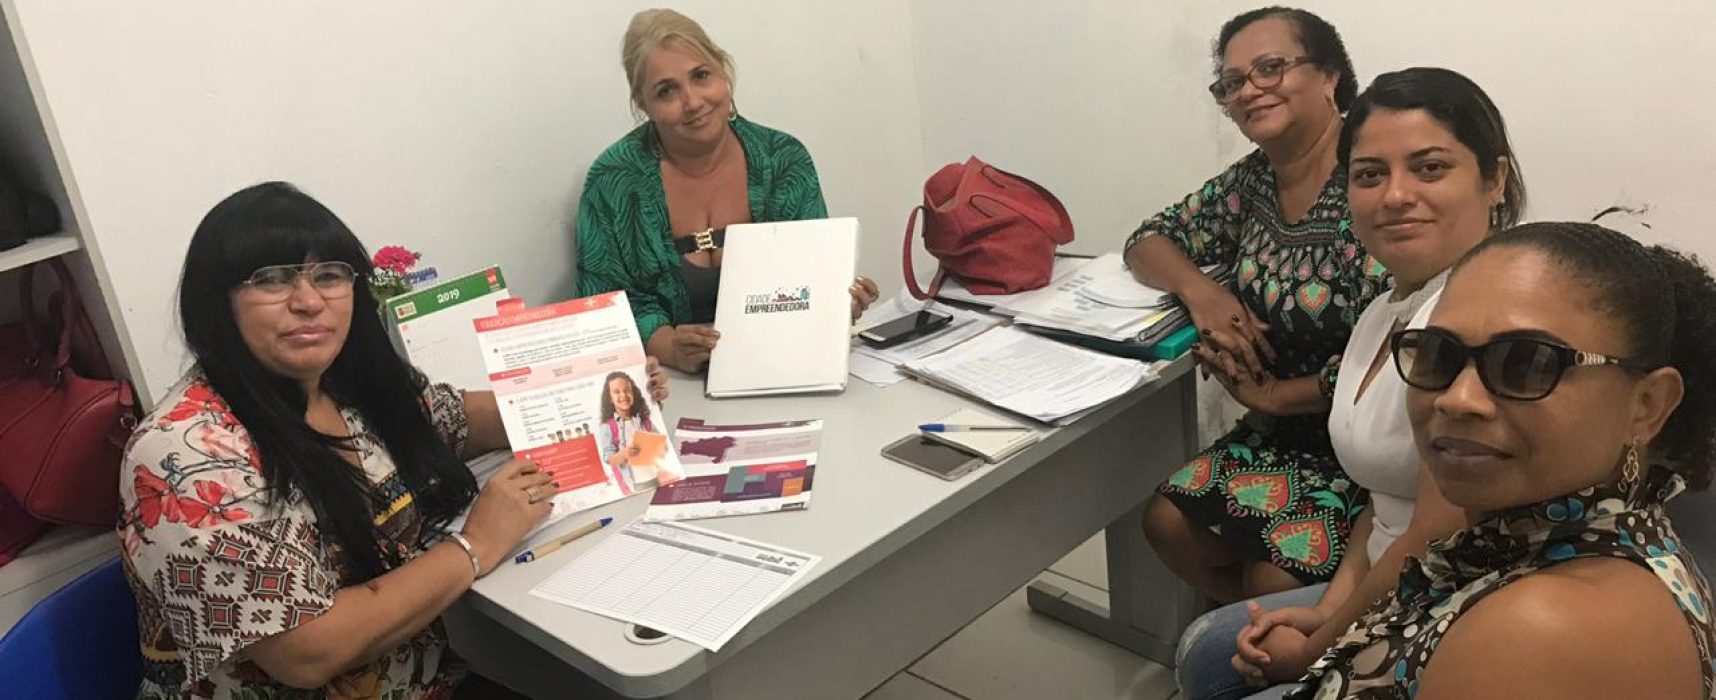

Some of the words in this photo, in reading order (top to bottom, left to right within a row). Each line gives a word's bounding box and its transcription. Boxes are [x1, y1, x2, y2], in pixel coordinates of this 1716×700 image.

[437, 288, 460, 303] 2019
[745, 294, 771, 304] CIDADE
[745, 301, 809, 314] EMPREENDEDORA
